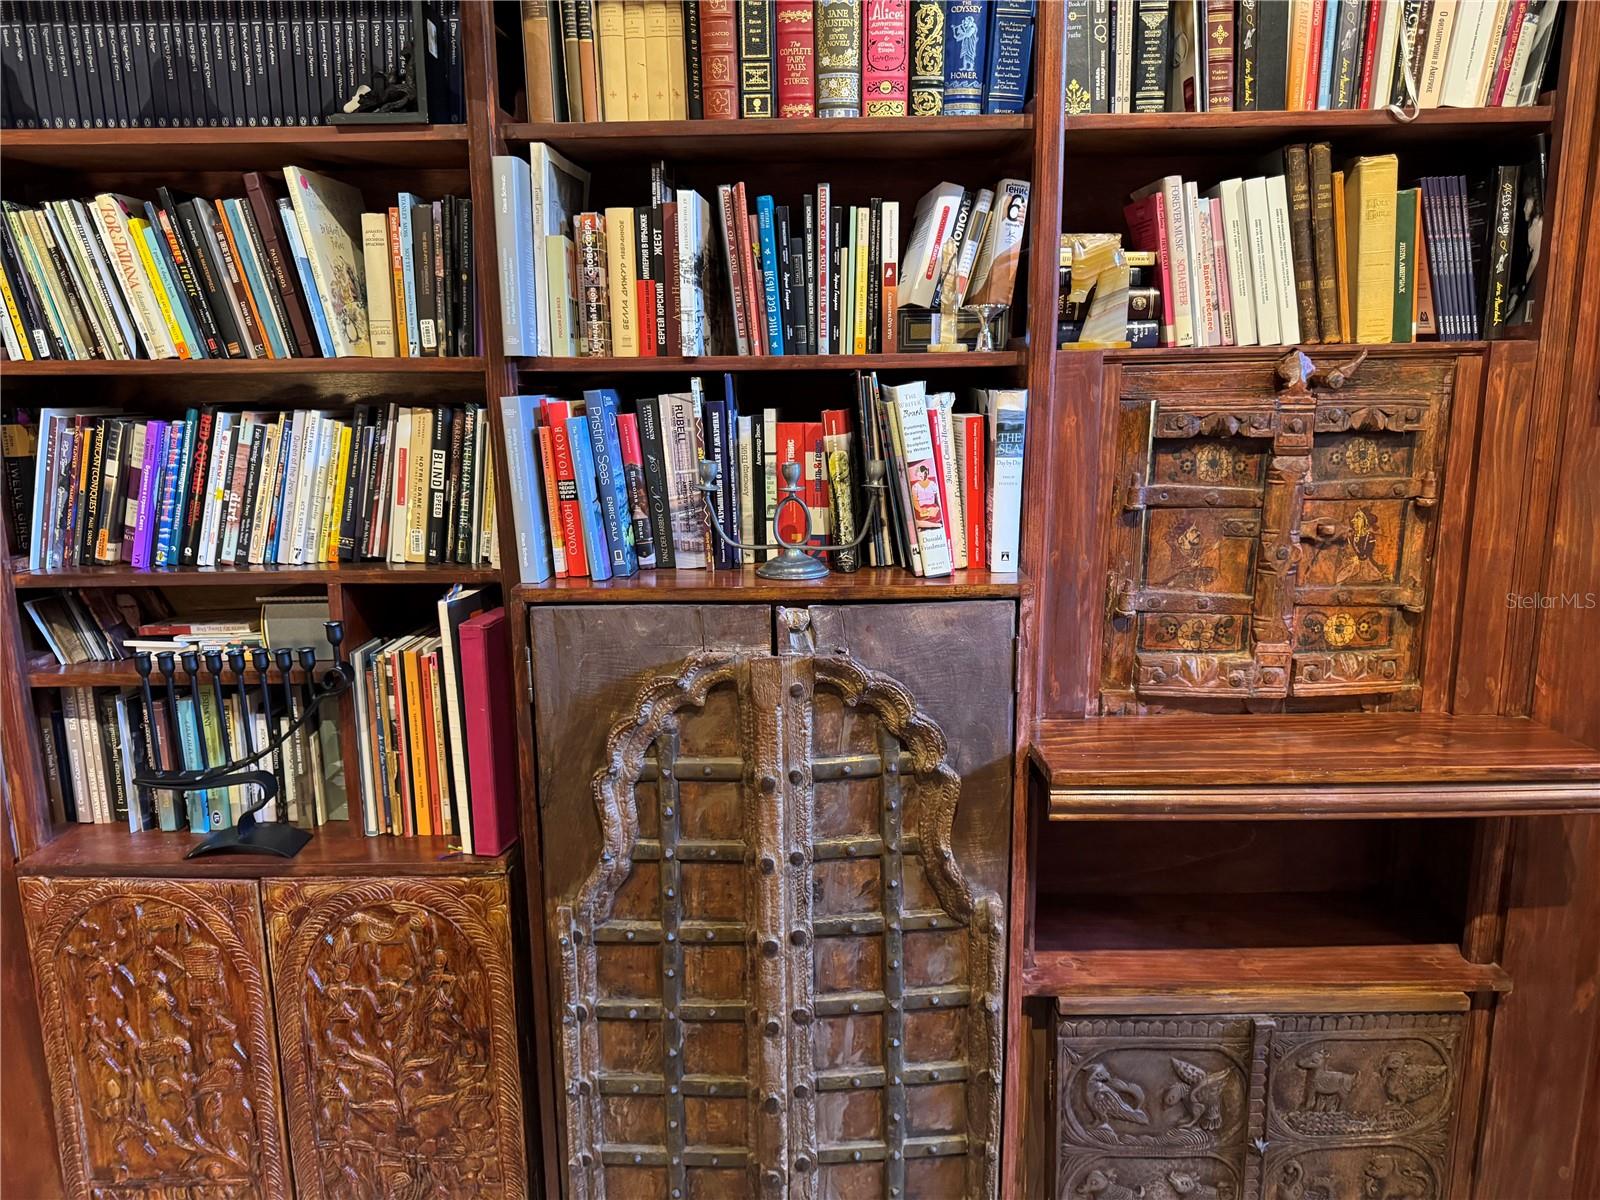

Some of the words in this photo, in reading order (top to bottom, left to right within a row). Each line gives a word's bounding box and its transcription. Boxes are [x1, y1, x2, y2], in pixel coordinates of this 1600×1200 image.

[824, 18, 854, 27] AUSTEN
[828, 10, 848, 18] JANE
[780, 47, 812, 55] COMPLETE
[692, 57, 700, 100] PUSHKIN
[722, 191, 732, 227] SHADOW
[727, 230, 734, 242] OF
[1171, 185, 1182, 224] FOREVER
[391, 213, 399, 231] Poem
[640, 214, 648, 242] ПРЫЖКЕ
[820, 230, 826, 240] OF
[100, 204, 121, 240] FOR
[113, 237, 140, 289] TATIANA
[584, 218, 595, 275] СЛОВОСФЕРА
[653, 228, 663, 256] ЖЕСТ
[1173, 225, 1184, 253] MUSIC
[270, 248, 280, 265] PAUL
[275, 266, 287, 288] SOROS
[642, 250, 650, 279] ИМПЕРИЯ
[620, 262, 629, 297] ДИЖУР
[764, 271, 775, 292] ЛЬЗЯ
[1177, 259, 1188, 306] SCHAEFFER
[1203, 264, 1211, 297] Вдвоем
[589, 287, 597, 312] Кацов
[654, 283, 664, 316] ЮРСКИЙ
[734, 286, 743, 308] ТЕНЬ
[621, 299, 630, 330] БЕЛЛА
[737, 311, 745, 336] ДУШИ
[768, 314, 778, 336] МНЕ
[1205, 298, 1214, 331] веселее
[590, 314, 599, 352] Геннадий
[657, 317, 666, 344] СЕРГЕЙ
[200, 415, 212, 440] RED
[465, 410, 475, 432] THE
[589, 406, 605, 453] Pristine
[645, 404, 655, 440] KUNSTHALLE
[675, 404, 685, 444] RUBELL
[92, 425, 103, 467] AMERICAN
[182, 420, 192, 454] Swimming
[291, 435, 300, 457] Queen
[452, 419, 462, 459] EARRINGS
[554, 426, 568, 476] ВОЛКОВ
[999, 432, 1022, 442] THE
[999, 443, 1022, 453] SEA
[250, 441, 260, 463] Warning:
[462, 433, 474, 474] NATURE
[740, 444, 749, 464] ГЕНИС
[192, 442, 208, 495] SQUARE
[432, 452, 443, 487] BLIND
[462, 475, 471, 486] OF
[596, 455, 611, 485] Seas
[741, 464, 750, 496] Александр
[287, 479, 295, 495] Jews
[227, 493, 240, 522] dirt
[434, 495, 442, 516] SPEED
[459, 488, 469, 528] NATURE
[606, 496, 616, 519] ENRIC
[564, 504, 578, 555] СОЛОМОН
[610, 521, 619, 541] SALA
[657, 514, 666, 535] FARBEN
[659, 536, 667, 547] DER
[661, 549, 669, 563] TANZ
